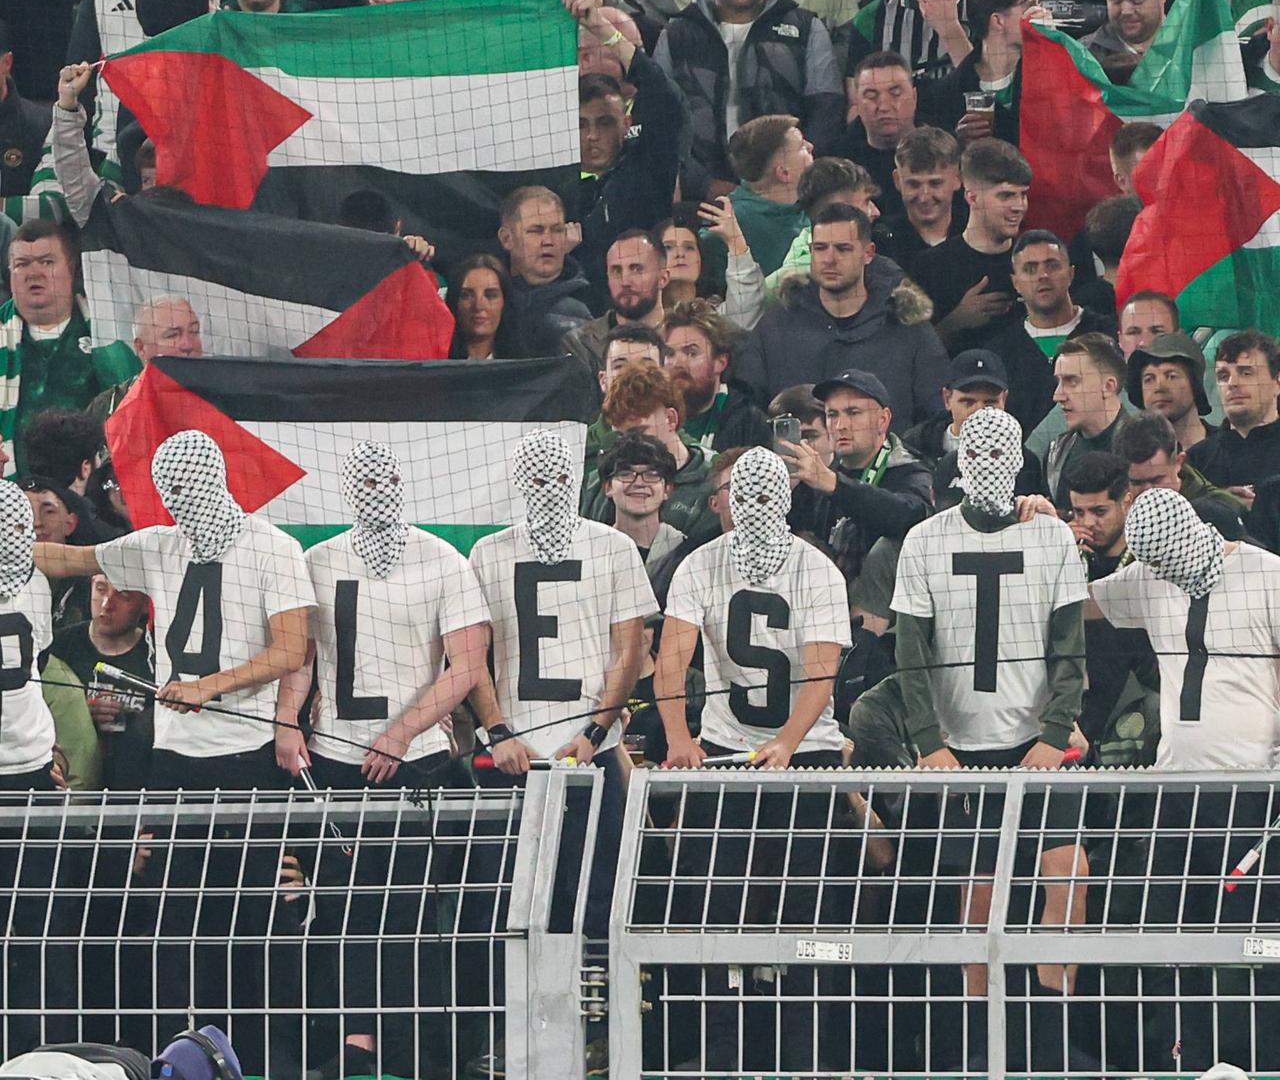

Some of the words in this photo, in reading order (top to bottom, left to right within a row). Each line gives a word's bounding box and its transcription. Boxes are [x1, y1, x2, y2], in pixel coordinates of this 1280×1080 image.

[165, 562, 222, 701] A
[336, 580, 388, 720] L
[514, 560, 582, 701] E
[726, 589, 791, 728] S
[952, 551, 1023, 692] T
[1182, 594, 1209, 722] I
